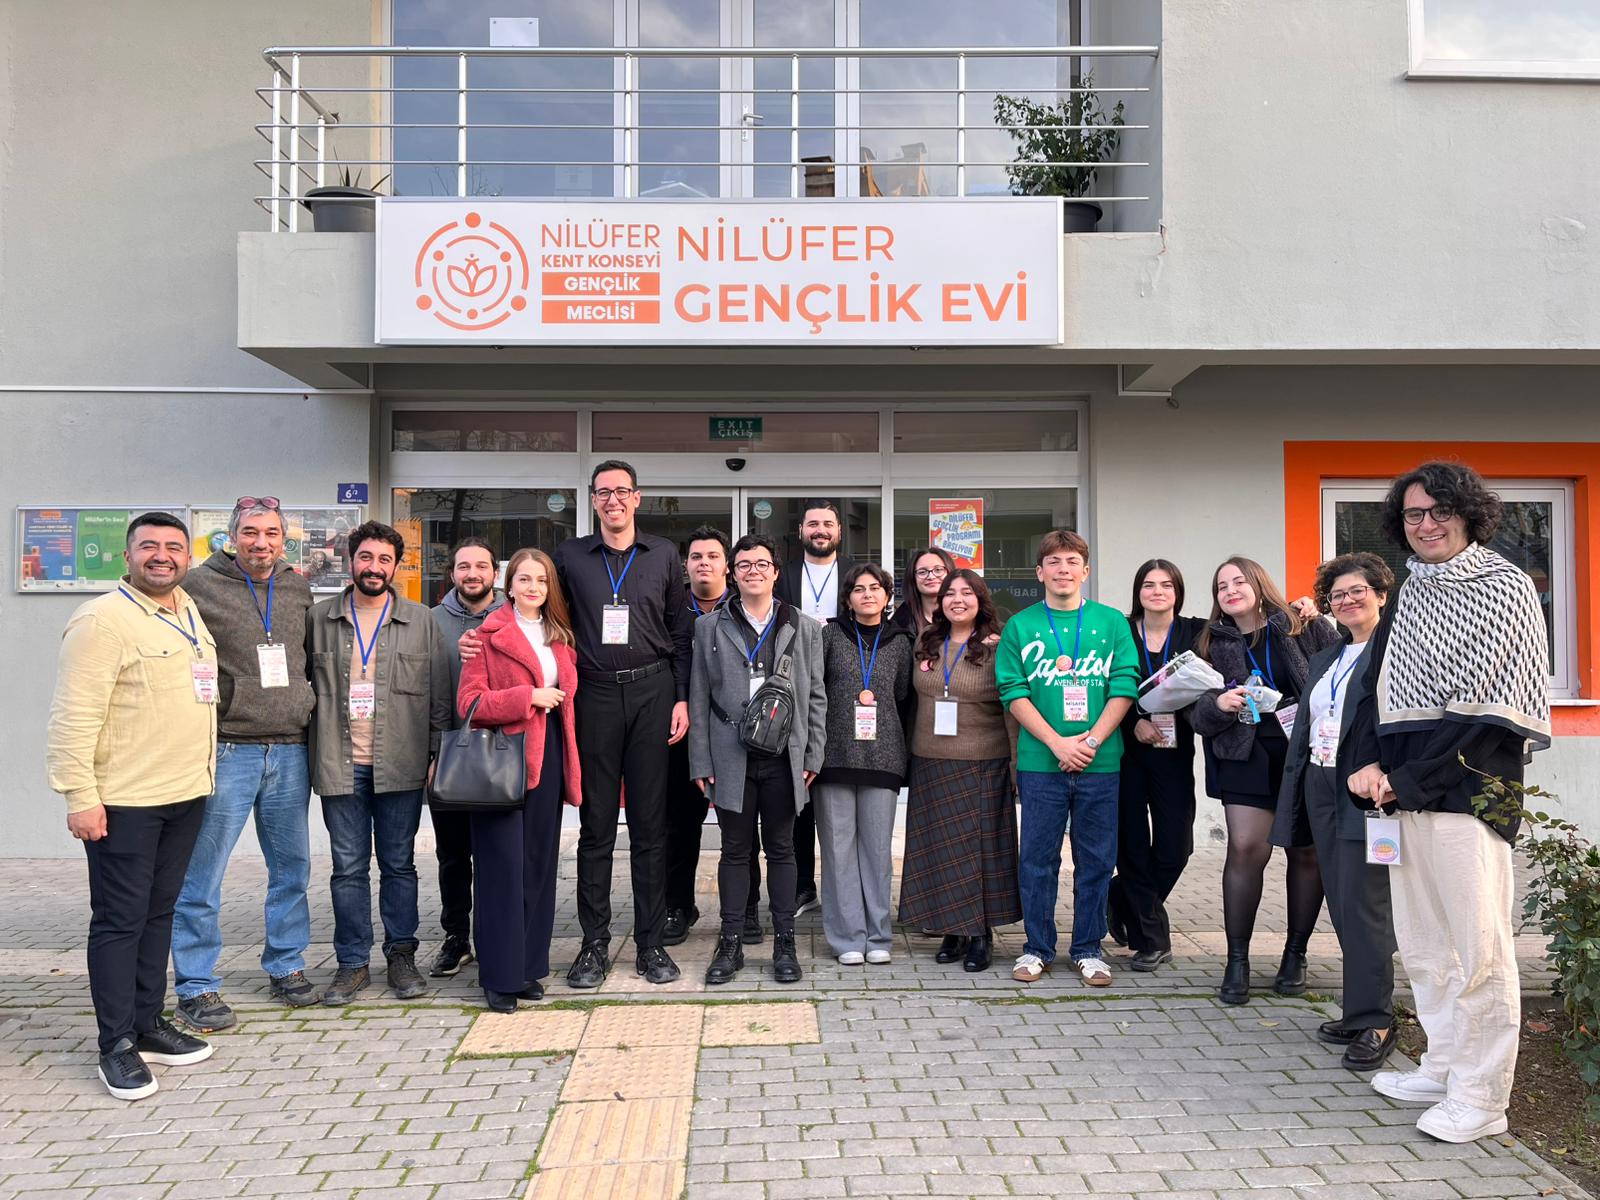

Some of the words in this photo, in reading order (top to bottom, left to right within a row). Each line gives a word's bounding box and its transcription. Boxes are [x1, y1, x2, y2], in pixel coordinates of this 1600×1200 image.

[541, 218, 661, 248] NİLÜFER
[677, 217, 895, 262] NİLÜFER
[541, 254, 584, 268] KENT
[588, 250, 661, 268] KONSEYİ
[564, 273, 641, 295] GENÇLİK
[567, 302, 636, 320] MECLİSİ
[673, 271, 923, 335] GENÇLİK
[941, 270, 1027, 322] EVİ
[718, 420, 753, 429] EXIT
